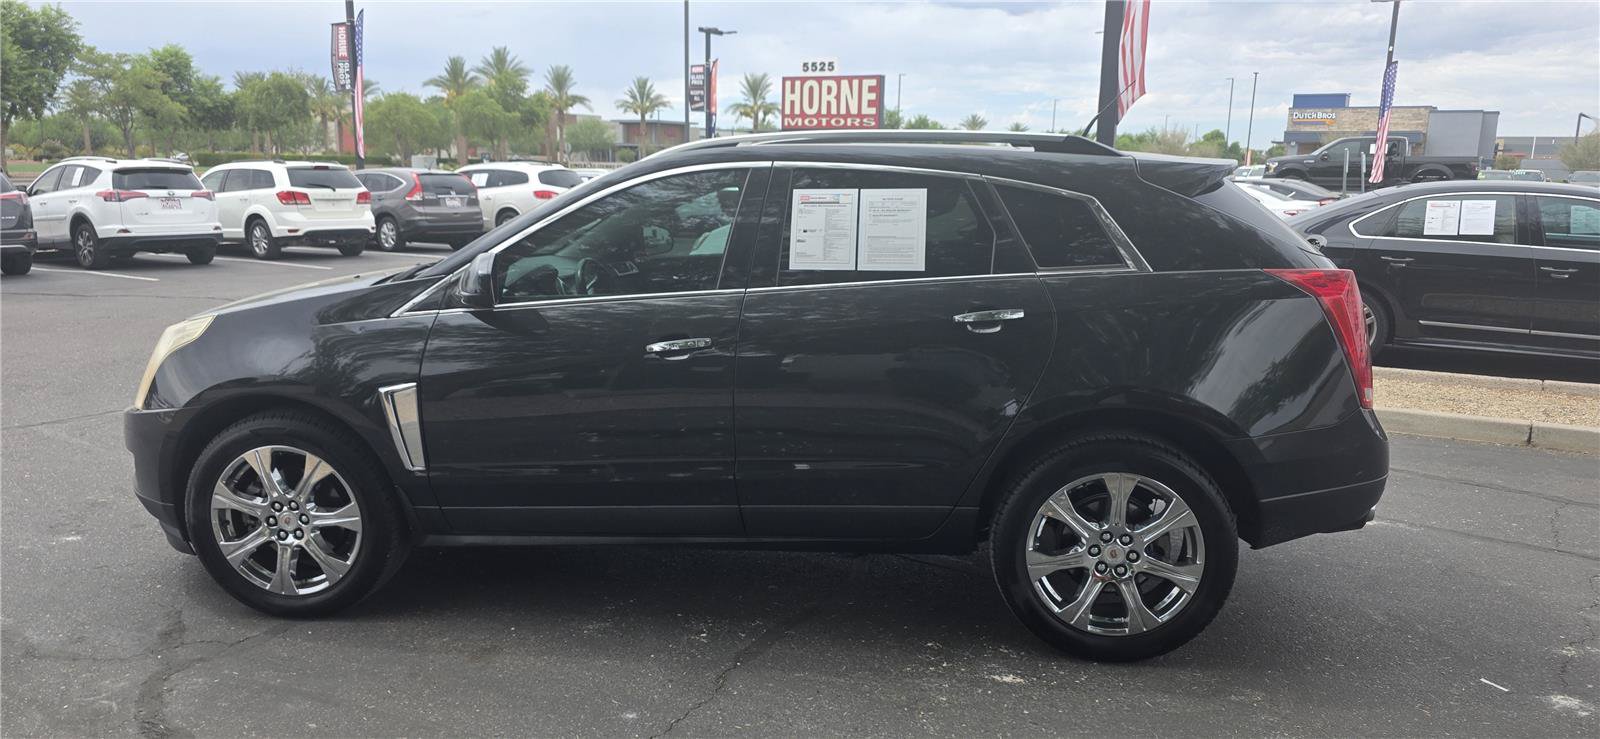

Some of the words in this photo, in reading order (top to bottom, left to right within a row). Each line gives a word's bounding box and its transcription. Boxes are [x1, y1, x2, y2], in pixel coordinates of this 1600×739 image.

[338, 26, 348, 58] HORNE
[338, 62, 346, 85] PROS
[802, 61, 835, 72] 5525
[785, 79, 877, 115] HORNE
[784, 117, 876, 127] MOTORS
